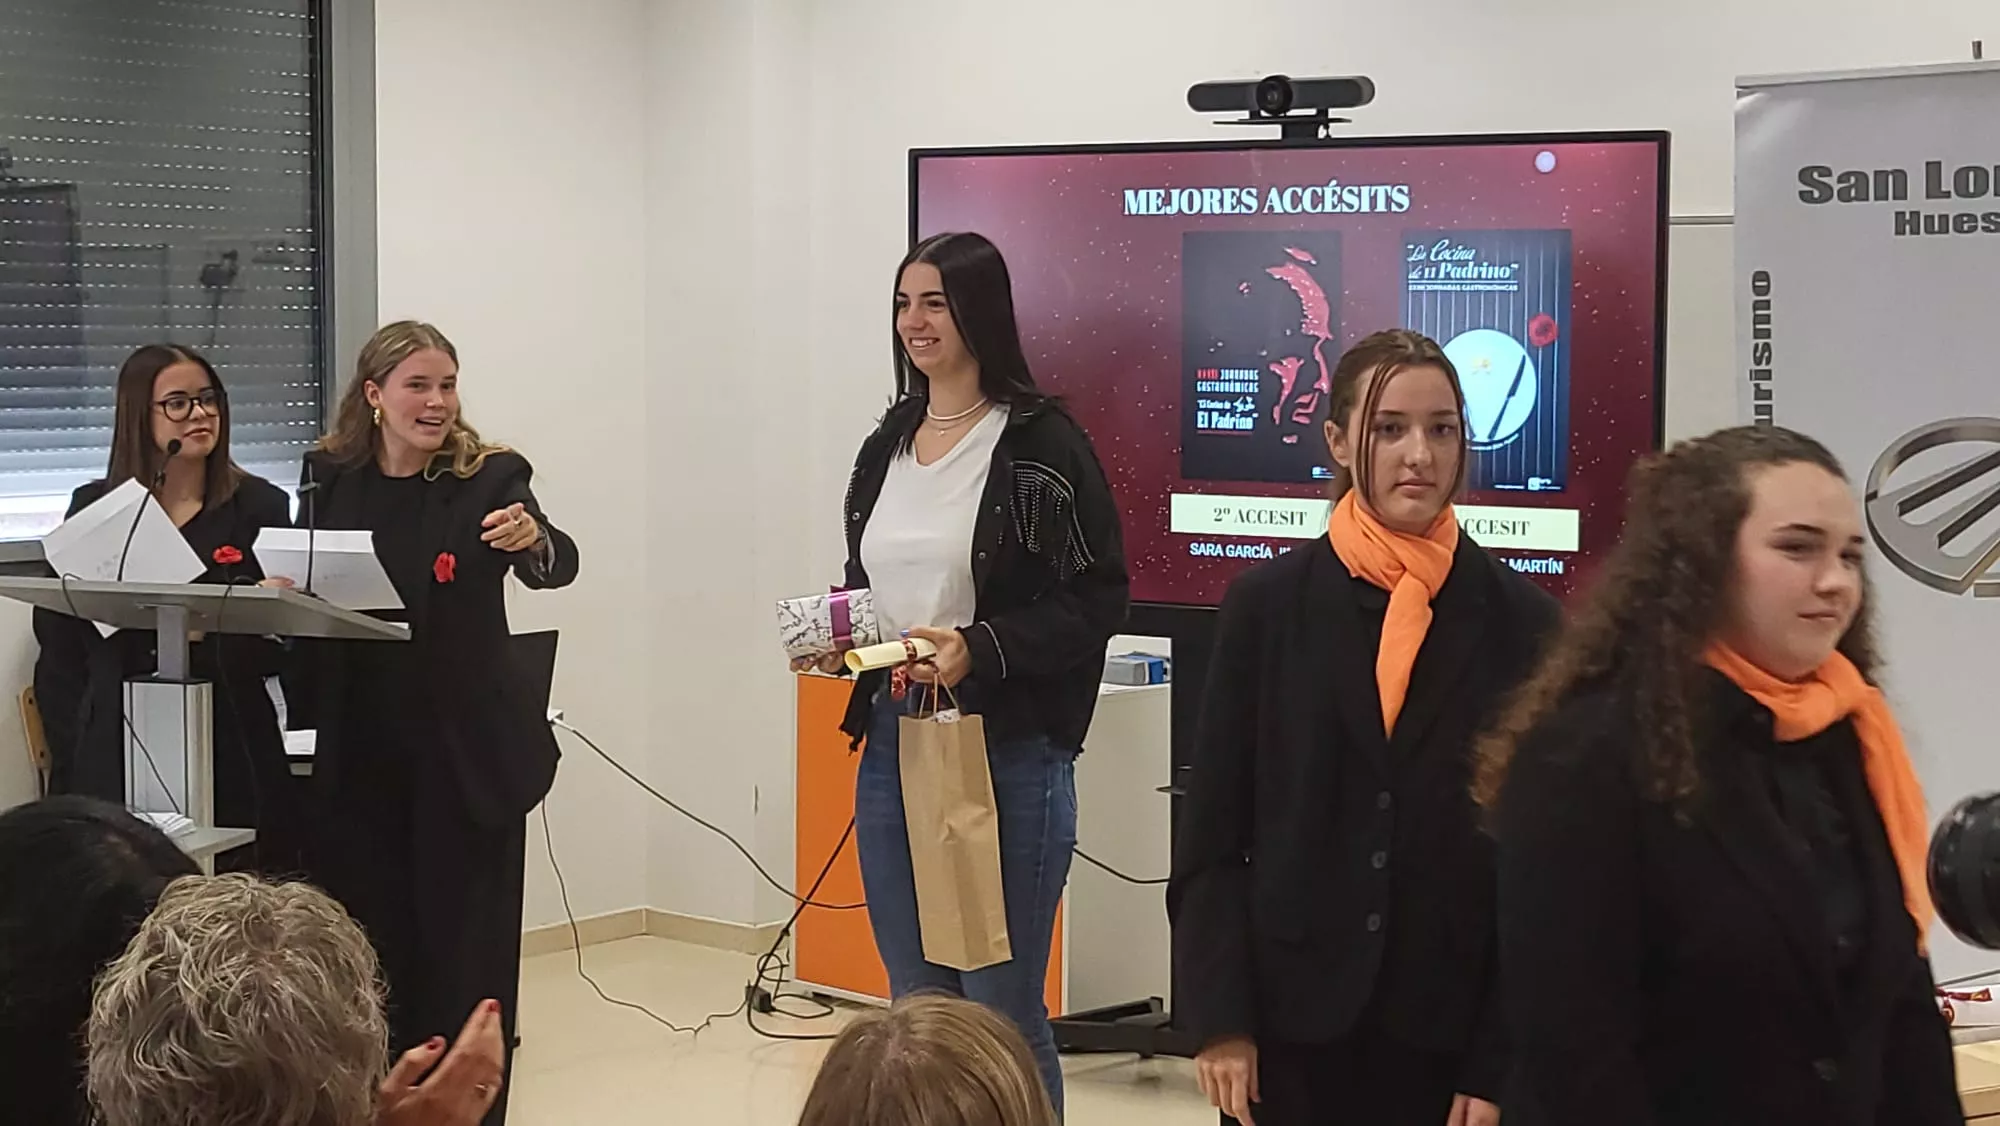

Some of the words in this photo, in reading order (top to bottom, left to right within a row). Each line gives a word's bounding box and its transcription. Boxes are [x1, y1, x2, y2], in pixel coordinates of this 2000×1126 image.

[1798, 165, 1908, 204] San
[1925, 160, 2000, 199] Lo
[1123, 188, 1258, 215] MEJORES
[1262, 179, 1410, 214] ACCÉSITS
[1430, 239, 1476, 261] Cocina
[1750, 271, 1773, 426] urismo
[1197, 411, 1209, 428] El
[1234, 508, 1308, 526] ACCESIT
[1464, 518, 1530, 536] CCESIT
[1190, 542, 1224, 557] SARA
[1225, 543, 1273, 559] GARCÍA
[1508, 557, 1564, 575] MARTÍN
